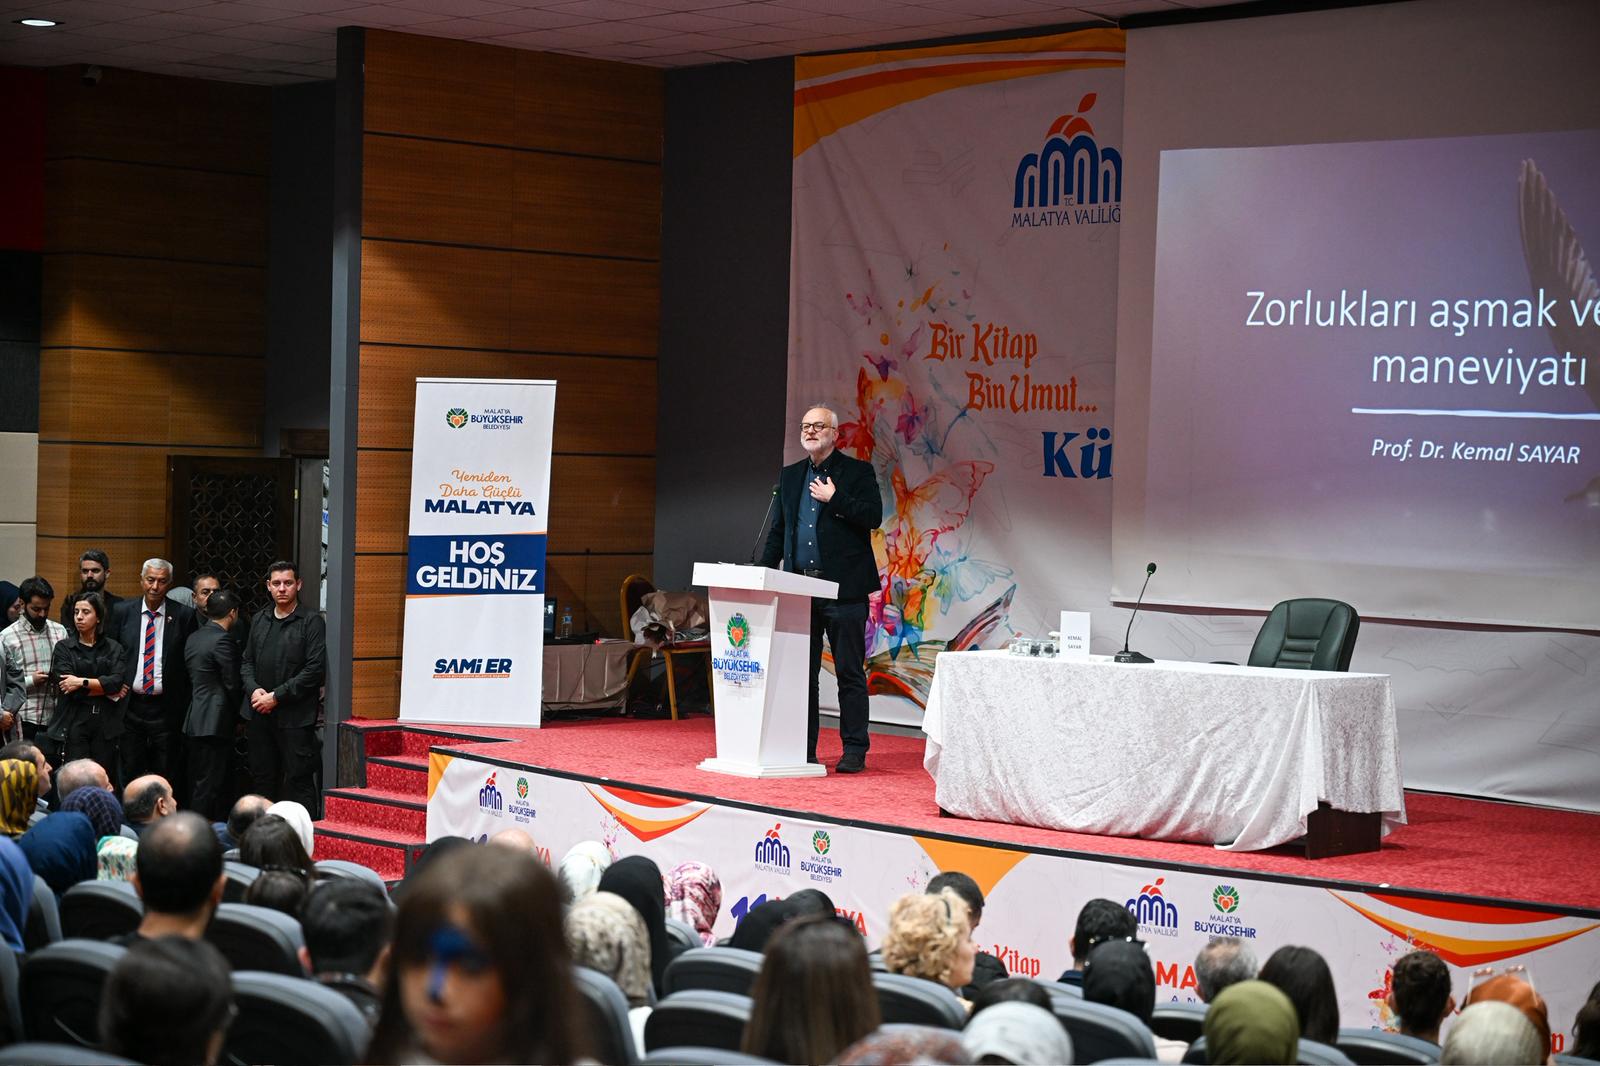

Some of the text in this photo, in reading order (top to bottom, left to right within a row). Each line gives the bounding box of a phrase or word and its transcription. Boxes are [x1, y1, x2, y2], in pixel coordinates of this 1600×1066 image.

[1011, 211, 1070, 228] MALATYA
[1246, 289, 1417, 327] Zorlukları
[1429, 288, 1557, 337] aşmak
[923, 321, 1039, 368] Bir Kitap
[1371, 348, 1587, 395] maneviyatı
[965, 370, 1098, 414] Bin Umut...
[1371, 438, 1581, 464] Prof. Dr. Kemal SAYAR
[451, 469, 512, 483] Yeniden
[439, 483, 523, 500] Daha Güçlü
[424, 499, 536, 516] MALATYA
[449, 540, 506, 567] HOŞ
[484, 658, 513, 674] ER
[1209, 915, 1242, 924] MALATYA
